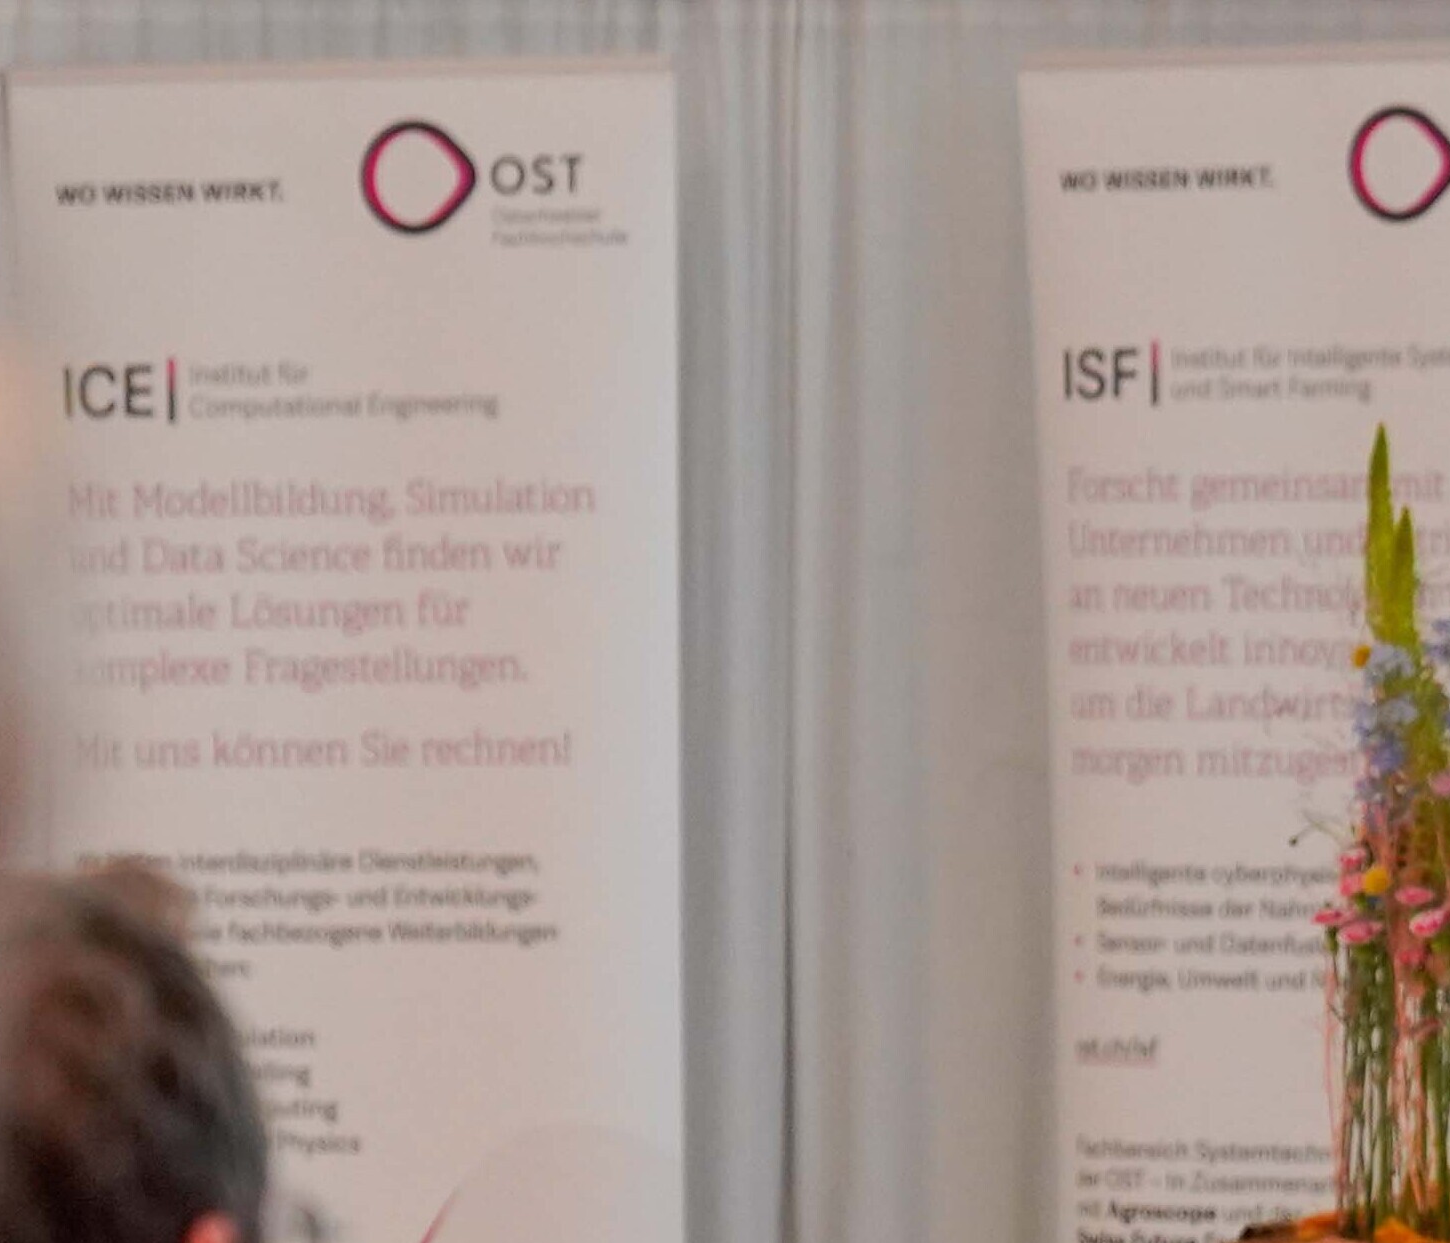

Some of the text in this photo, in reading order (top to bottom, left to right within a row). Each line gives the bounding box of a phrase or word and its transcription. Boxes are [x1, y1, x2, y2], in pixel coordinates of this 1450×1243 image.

[490, 154, 581, 195] OST
[1061, 166, 1275, 191] WO WISSEN WIRKT.
[56, 179, 284, 206] WO WISSEN WIRKT.
[189, 361, 309, 387] Institut für
[1063, 347, 1139, 402] ISF
[1171, 346, 1246, 370] Institut
[1252, 345, 1281, 370] für
[1288, 345, 1402, 373] Intelligente
[63, 364, 155, 420] ICE
[188, 392, 499, 422] Computational Engineering
[1171, 376, 1372, 405] und Smart Farming
[1067, 468, 1179, 501] Forscht
[68, 478, 597, 526] Mit Modellbildung, Simulation
[141, 538, 225, 574] Data
[236, 537, 371, 572] Science
[382, 533, 491, 571] finden
[502, 534, 562, 570] wir
[1068, 521, 1290, 558] Unternehmen
[230, 590, 405, 637] Lösungen
[417, 587, 472, 628] für
[1113, 582, 1211, 612] neuen
[1068, 631, 1231, 666] entwickelt
[244, 645, 529, 693] Fragestellungen.
[1126, 685, 1177, 722] die
[74, 726, 572, 771] Mit uns können Sie rechnen!
[1072, 747, 1185, 786] morgen
[347, 886, 387, 908] und
[1219, 898, 1252, 918] der
[1173, 934, 1213, 953] und
[1107, 1200, 1218, 1223] Agroscope
